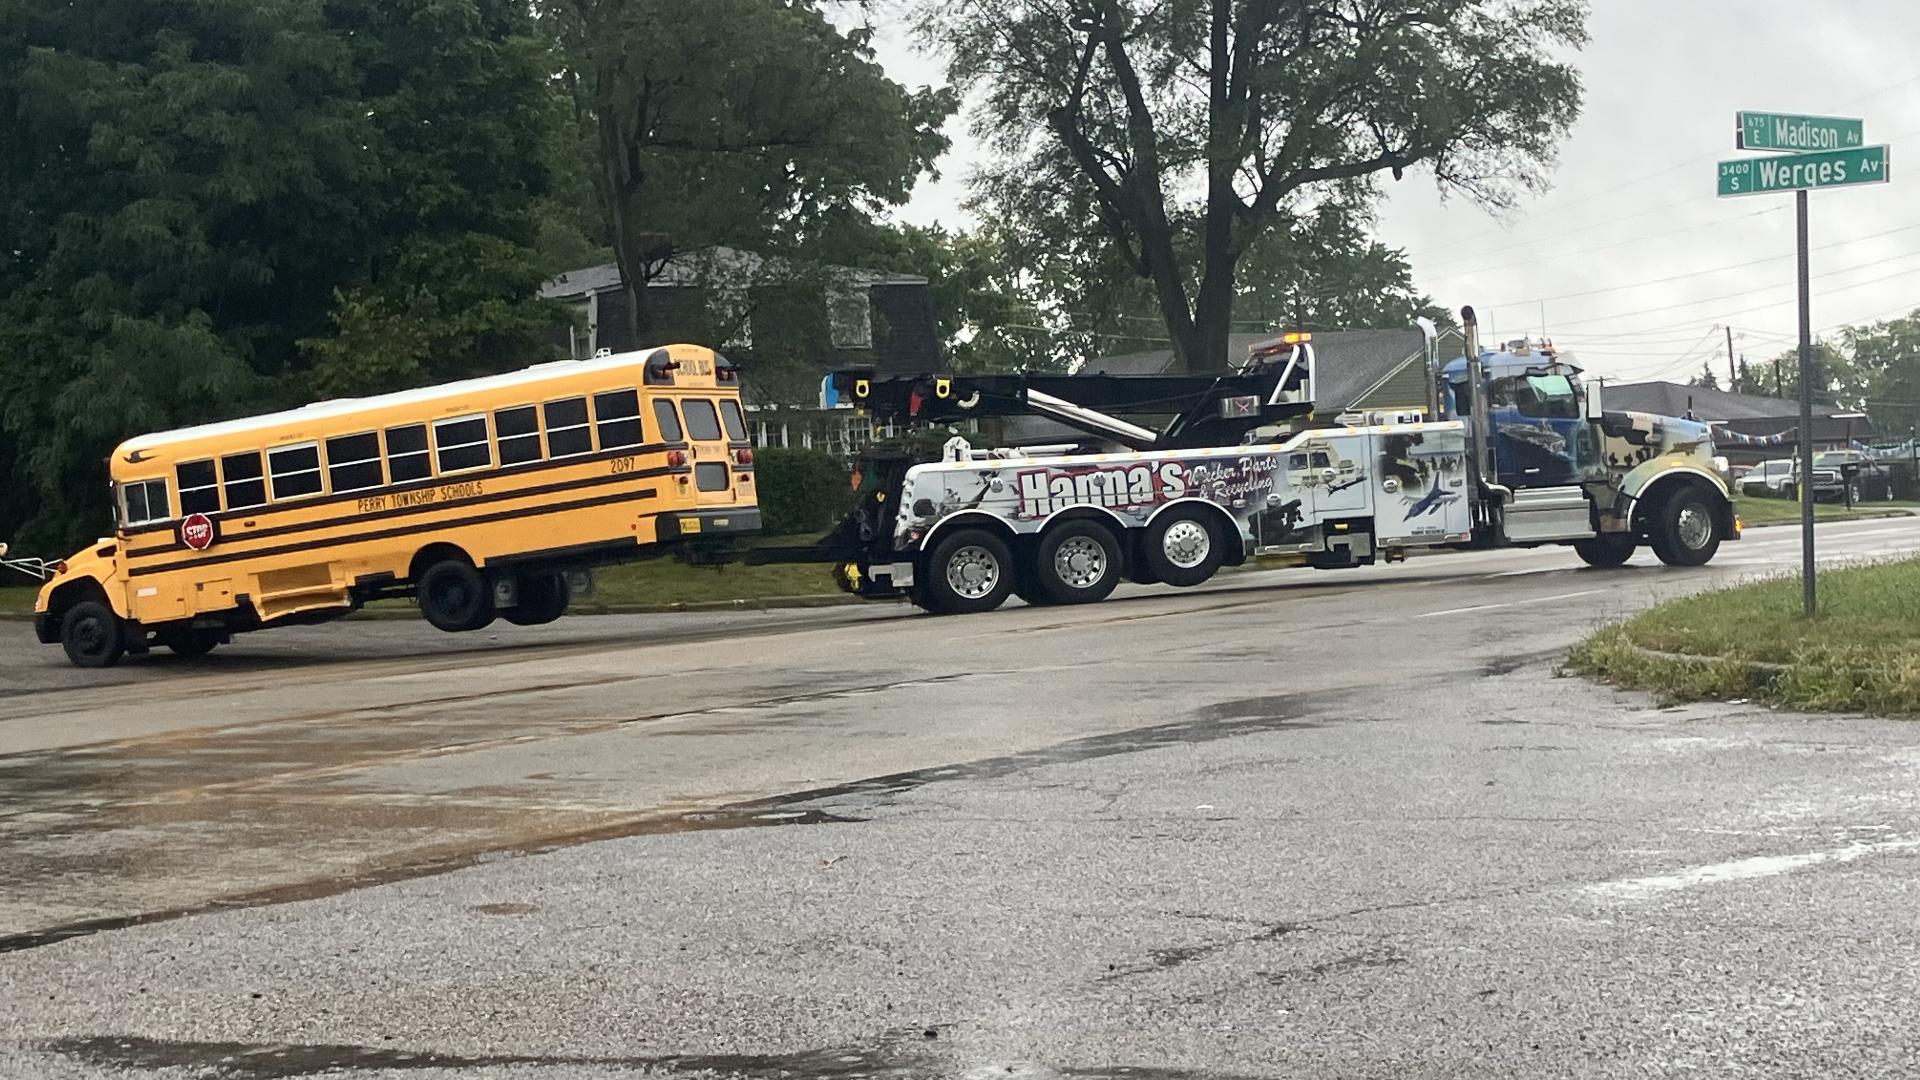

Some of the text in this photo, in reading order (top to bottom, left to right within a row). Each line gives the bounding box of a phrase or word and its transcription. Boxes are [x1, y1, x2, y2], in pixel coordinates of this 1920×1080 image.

[1753, 129, 1761, 144] E
[1775, 118, 1859, 148] Madison Av
[1721, 163, 1749, 176] 3400
[1759, 158, 1879, 188] Werges Av
[1731, 177, 1740, 190] S
[610, 457, 635, 473] 2097
[1020, 455, 1278, 517] Hanna's Wecker, Parts
[1199, 476, 1273, 499] & Recycling
[358, 481, 483, 513] PERRY TOWNSHIP SCHOOLS
[186, 524, 208, 541] STOP
